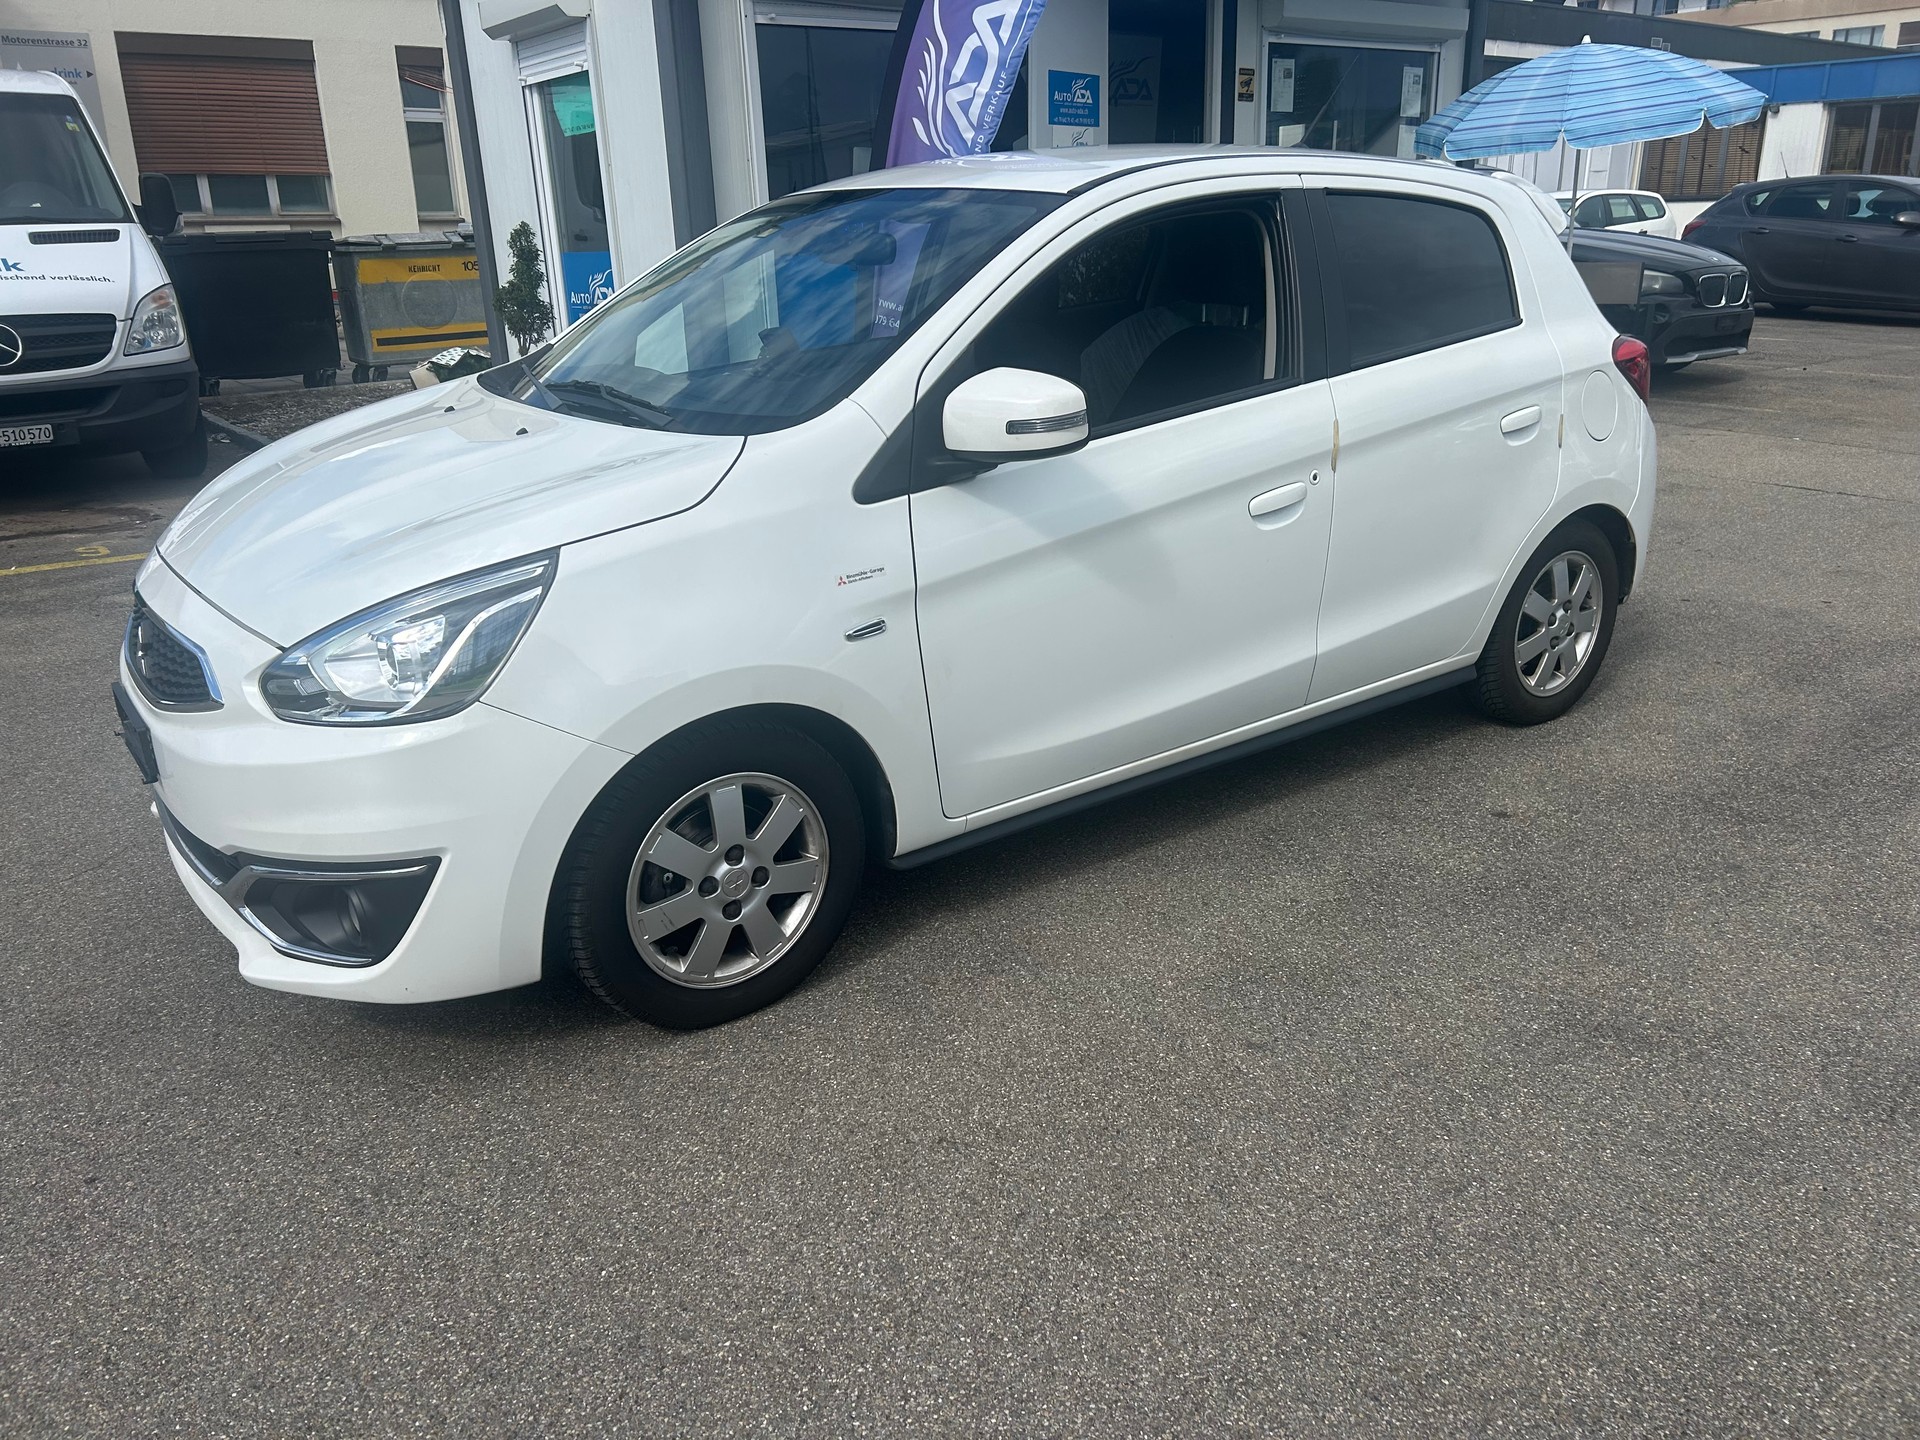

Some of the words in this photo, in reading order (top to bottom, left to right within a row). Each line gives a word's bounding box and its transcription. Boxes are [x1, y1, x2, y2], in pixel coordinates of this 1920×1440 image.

[1, 35, 75, 46] Motorenstrasse
[77, 39, 88, 47] 32
[983, 71, 1007, 130] VERKAUF
[1074, 89, 1093, 104] ADA
[0, 258, 25, 271] k
[408, 264, 441, 273] KEHRICHT
[50, 274, 115, 283] verlässlich.
[571, 291, 590, 304] AUTO
